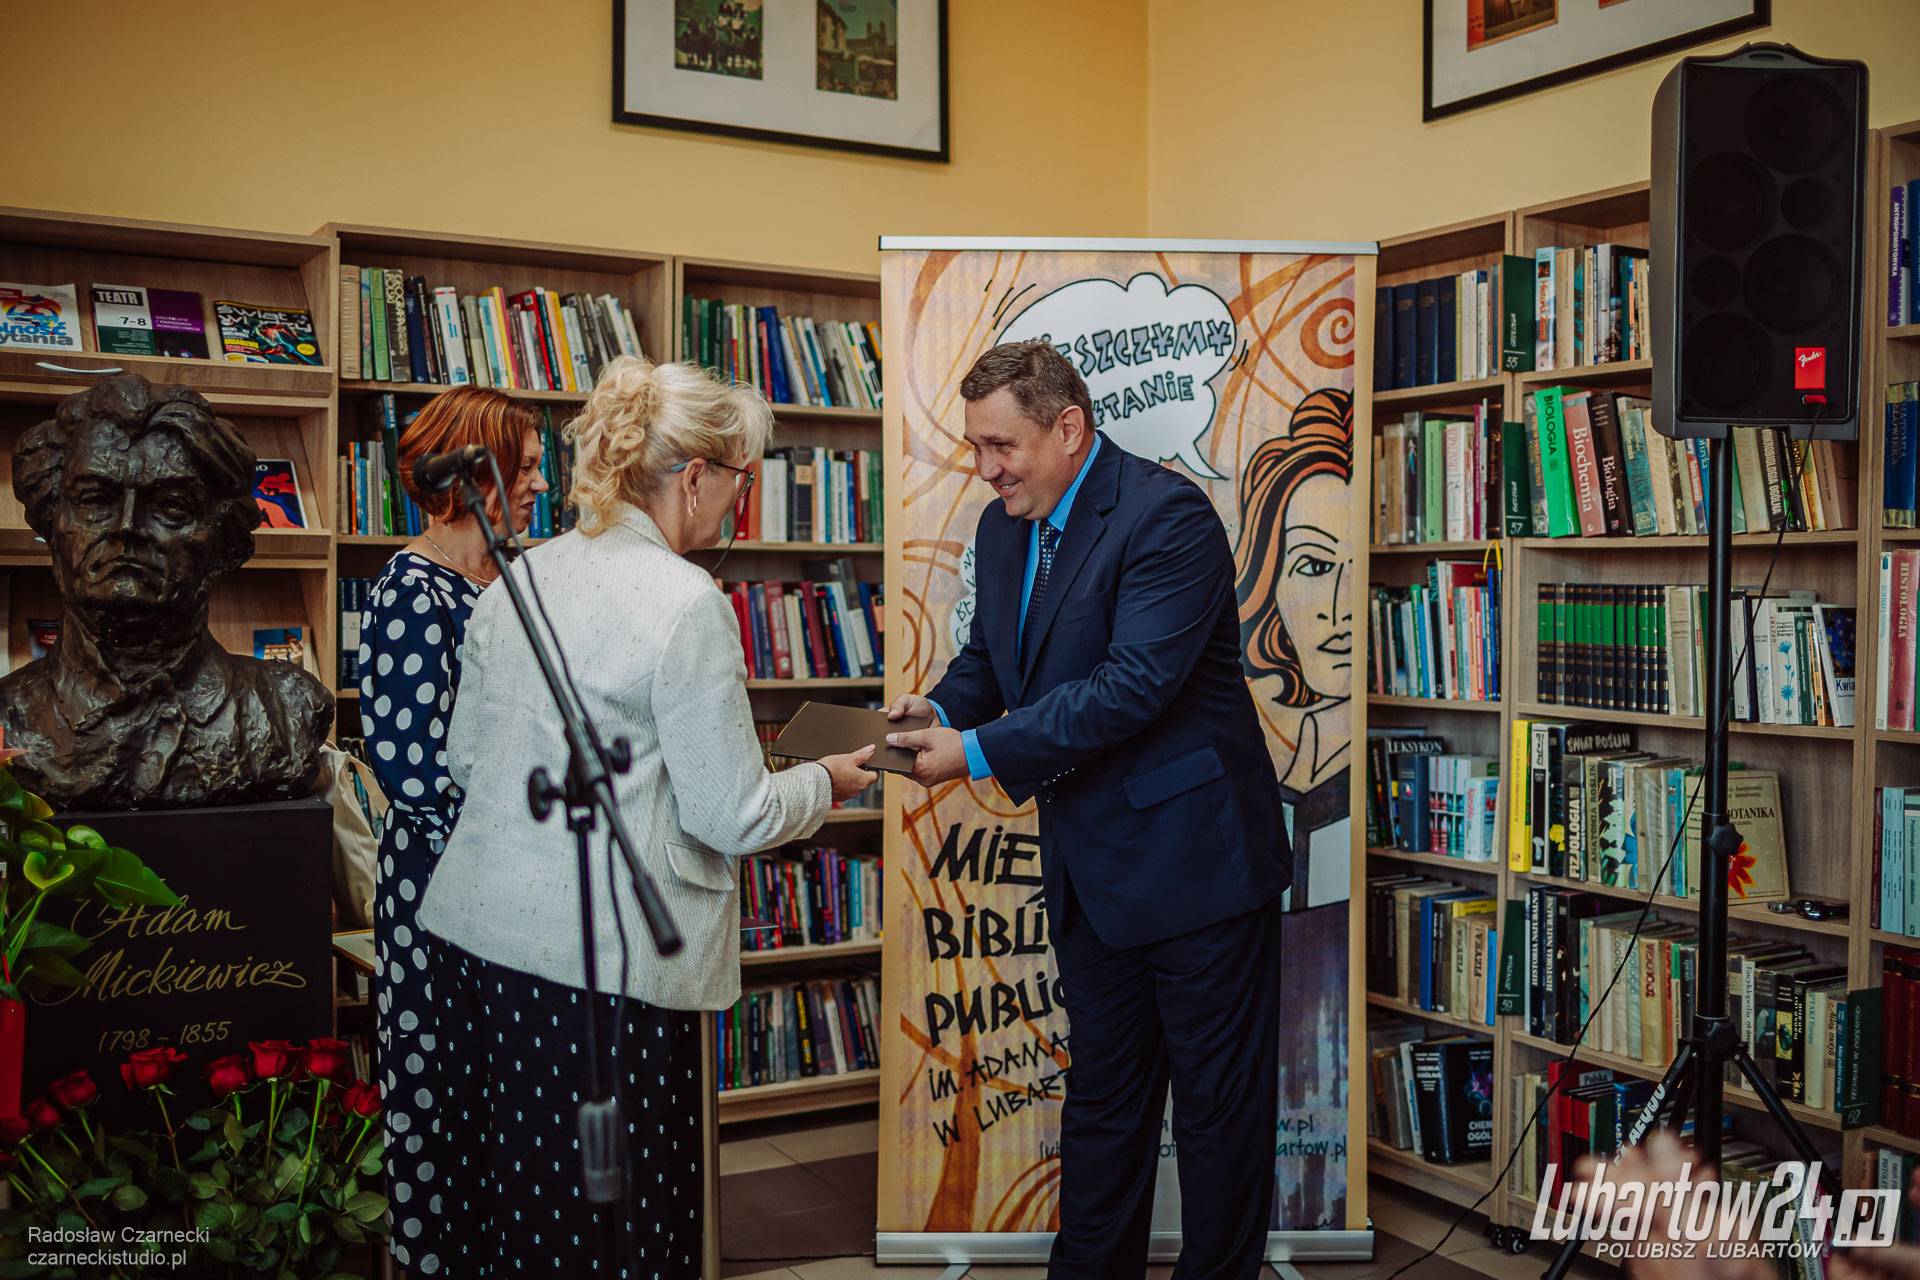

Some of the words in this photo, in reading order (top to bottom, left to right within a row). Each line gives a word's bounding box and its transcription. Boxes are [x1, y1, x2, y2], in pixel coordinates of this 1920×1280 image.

[1891, 202, 1900, 277] ANTROPOMOTORYKA
[96, 291, 139, 304] TEATR
[1505, 354, 1519, 370] 55
[1544, 394, 1558, 456] BIOLOGIA
[1571, 427, 1592, 513] Biochemia
[1601, 455, 1618, 511] Biologia
[1770, 487, 1782, 516] OGÓLNA
[1508, 520, 1522, 535] 57
[1898, 562, 1910, 639] HISTOLOGIA
[1388, 740, 1443, 753] LEKSYKON
[1566, 735, 1593, 753] ŚWIAT
[1595, 731, 1631, 750] ROŚLIN
[1568, 798, 1581, 879] FIZJOLOGIA
[1591, 810, 1599, 864] ANATOMIA
[70, 893, 249, 942] Adam
[30, 946, 307, 1006] Mickiewicz
[1474, 931, 1484, 979] FIZYKA
[1531, 943, 1539, 987] HISTORIA
[1545, 946, 1553, 992] HISTORIA
[1646, 942, 1656, 999] ZOOLOGIA
[1744, 965, 1753, 1019] Encyklopedia
[98, 1026, 149, 1052] 1798
[180, 1020, 231, 1044] 1855
[933, 1113, 961, 1147] W
